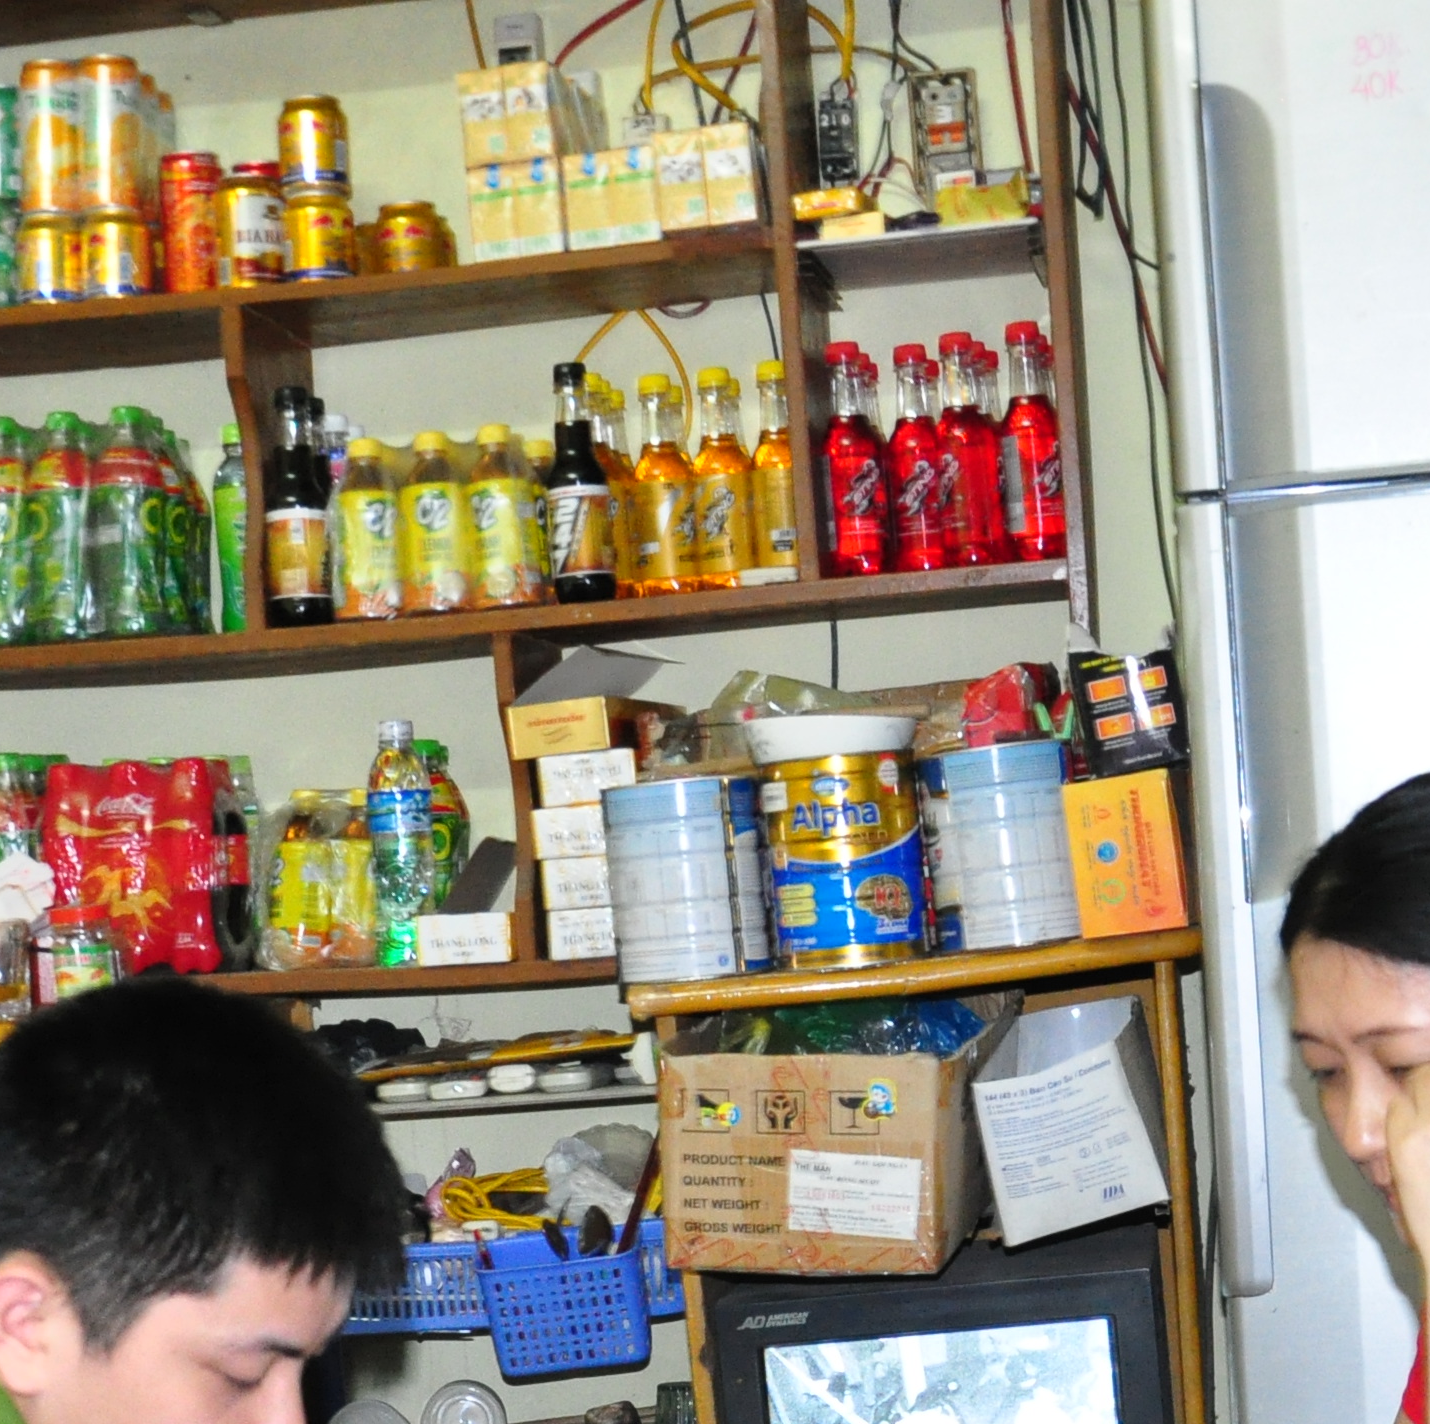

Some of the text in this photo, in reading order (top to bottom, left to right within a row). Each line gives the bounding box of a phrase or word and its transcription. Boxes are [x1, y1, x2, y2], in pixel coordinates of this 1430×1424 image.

[791, 797, 881, 838] Alpha
[683, 1152, 786, 1167] PRODUCT NAME
[683, 1176, 746, 1187] QUANTITY
[683, 1198, 761, 1211] NET WEIGHT
[684, 1222, 782, 1235] GROSS WEIGHT
[767, 1311, 810, 1324] AMERICAN
